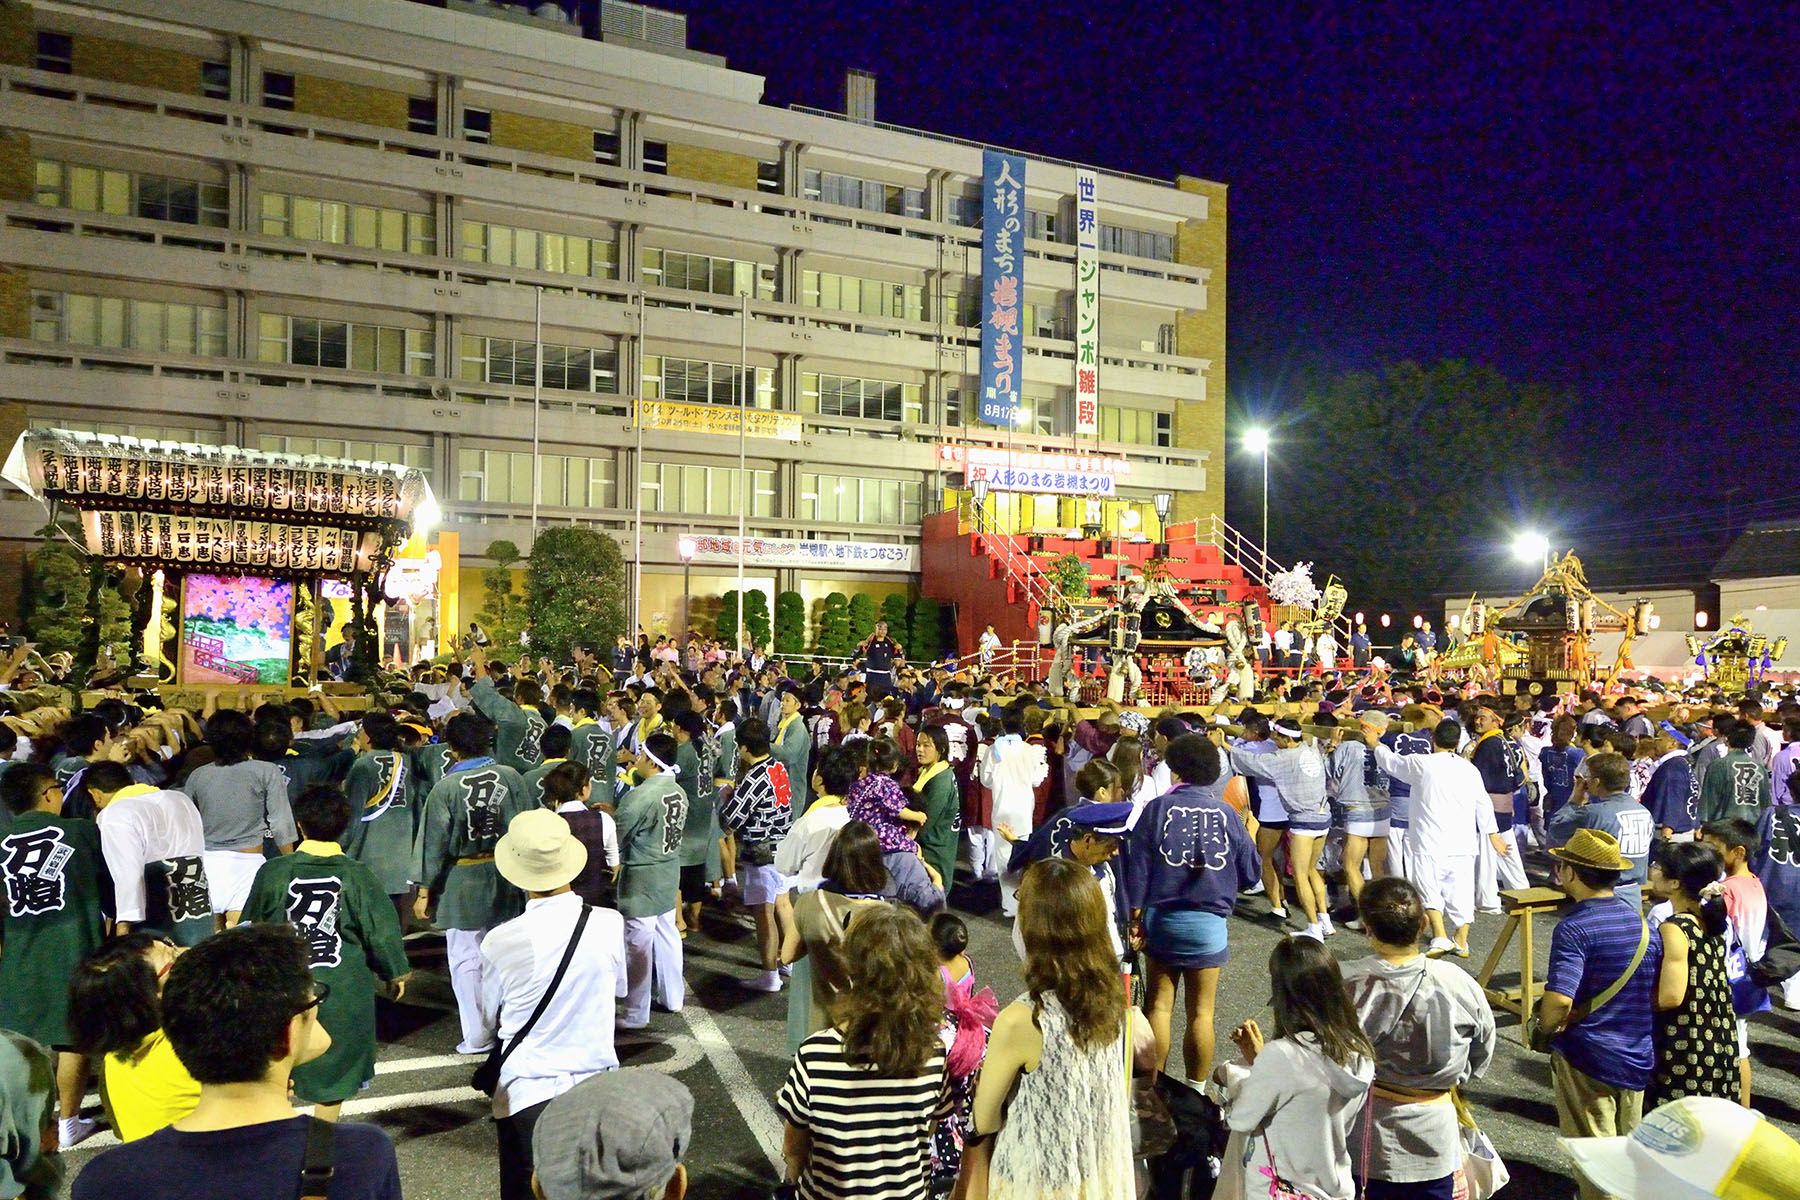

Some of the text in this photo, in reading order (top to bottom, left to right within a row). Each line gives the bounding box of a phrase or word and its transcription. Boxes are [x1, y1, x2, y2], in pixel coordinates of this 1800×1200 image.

[990, 159, 1021, 394] 人形のまち岩槻まつり
[1078, 176, 1096, 426] 世界一ジャンボ雛段
[991, 469, 1110, 492] 人形のまち岩槻まつり
